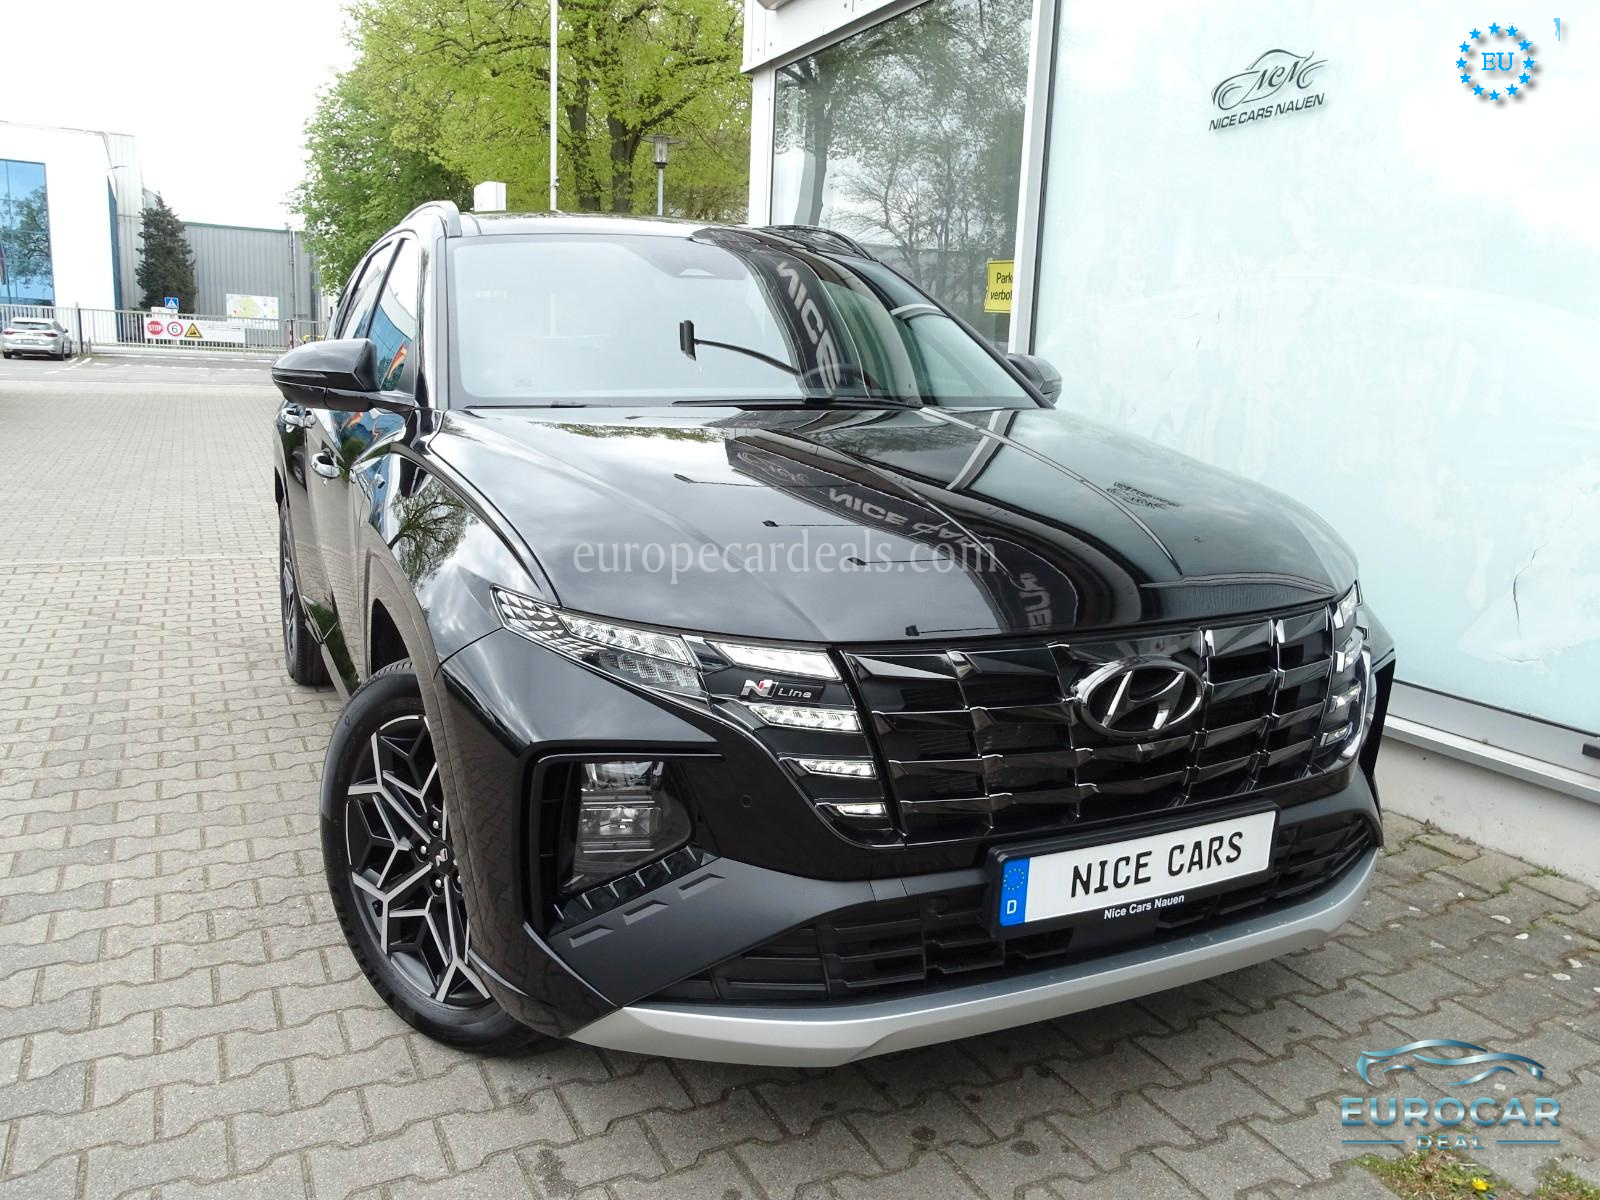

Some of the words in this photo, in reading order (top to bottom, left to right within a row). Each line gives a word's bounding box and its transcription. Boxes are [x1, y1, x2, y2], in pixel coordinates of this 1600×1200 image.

[1208, 114, 1237, 131] NICE
[1238, 105, 1274, 124] CARS
[1275, 93, 1325, 116] NAUEN
[148, 324, 162, 332] STOP
[171, 324, 179, 333] 6
[778, 687, 812, 698] Line
[1070, 850, 1153, 898] NICE
[1167, 831, 1244, 877] CARS
[1006, 899, 1017, 914] D
[1103, 906, 1127, 920] Nice
[1129, 900, 1152, 914] Cars
[1154, 893, 1185, 910] Nauen
